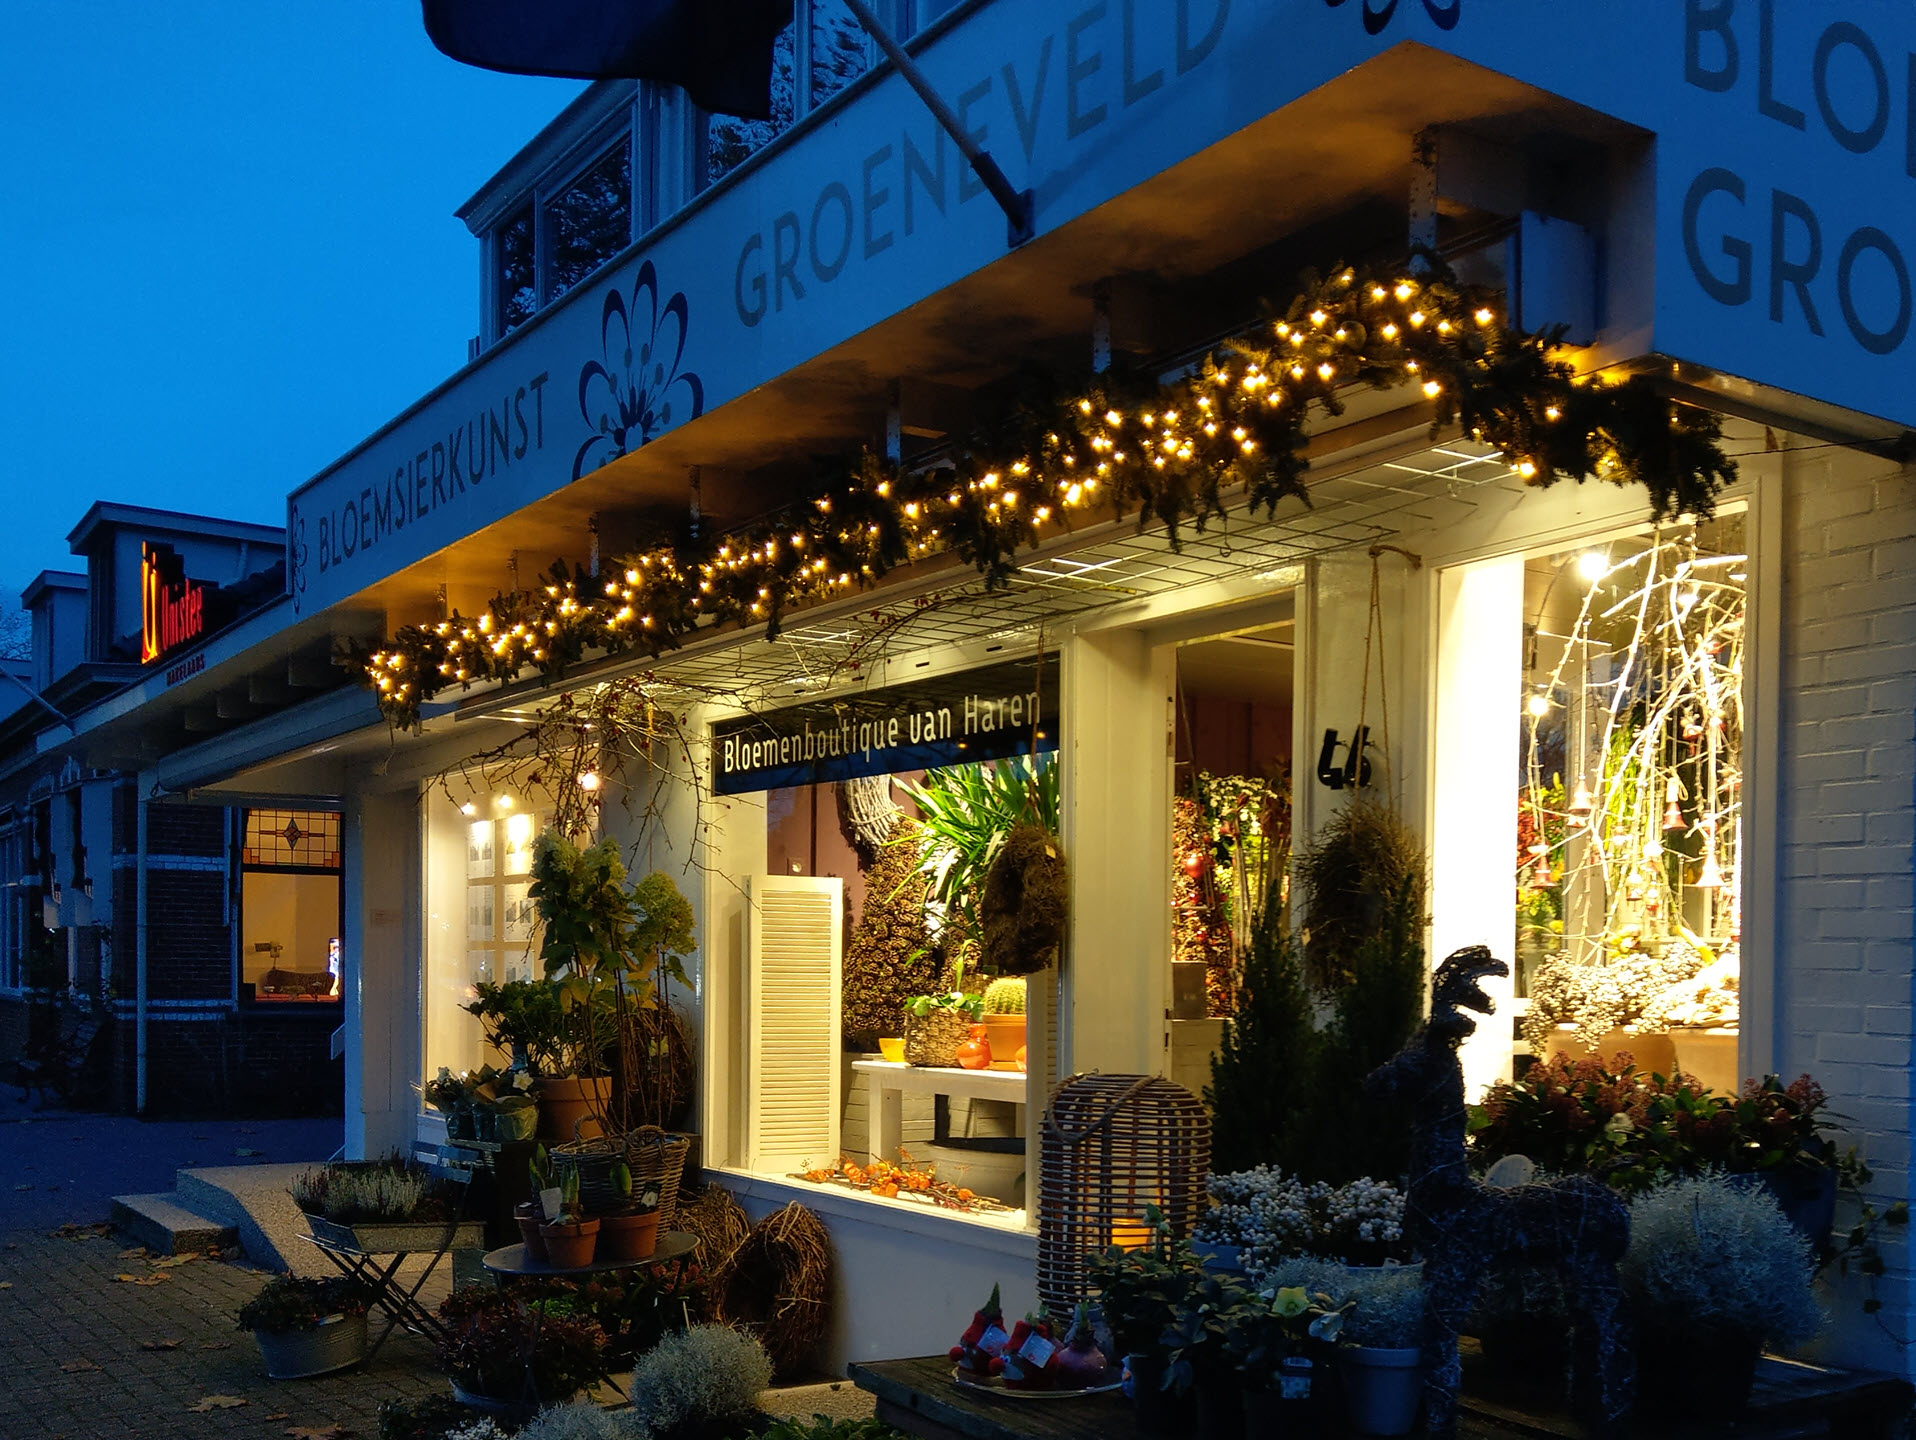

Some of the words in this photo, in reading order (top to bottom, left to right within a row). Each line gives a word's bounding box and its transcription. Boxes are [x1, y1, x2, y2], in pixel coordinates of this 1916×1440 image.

[319, 371, 549, 574] BLOEMSIERKUNST
[735, 0, 1231, 327] GROENEVELD
[1682, 167, 1912, 355] GRO
[724, 716, 899, 773] Bloemenboutique
[909, 706, 951, 745] van
[964, 691, 1040, 736] Haren
[1318, 725, 1371, 790] 46
